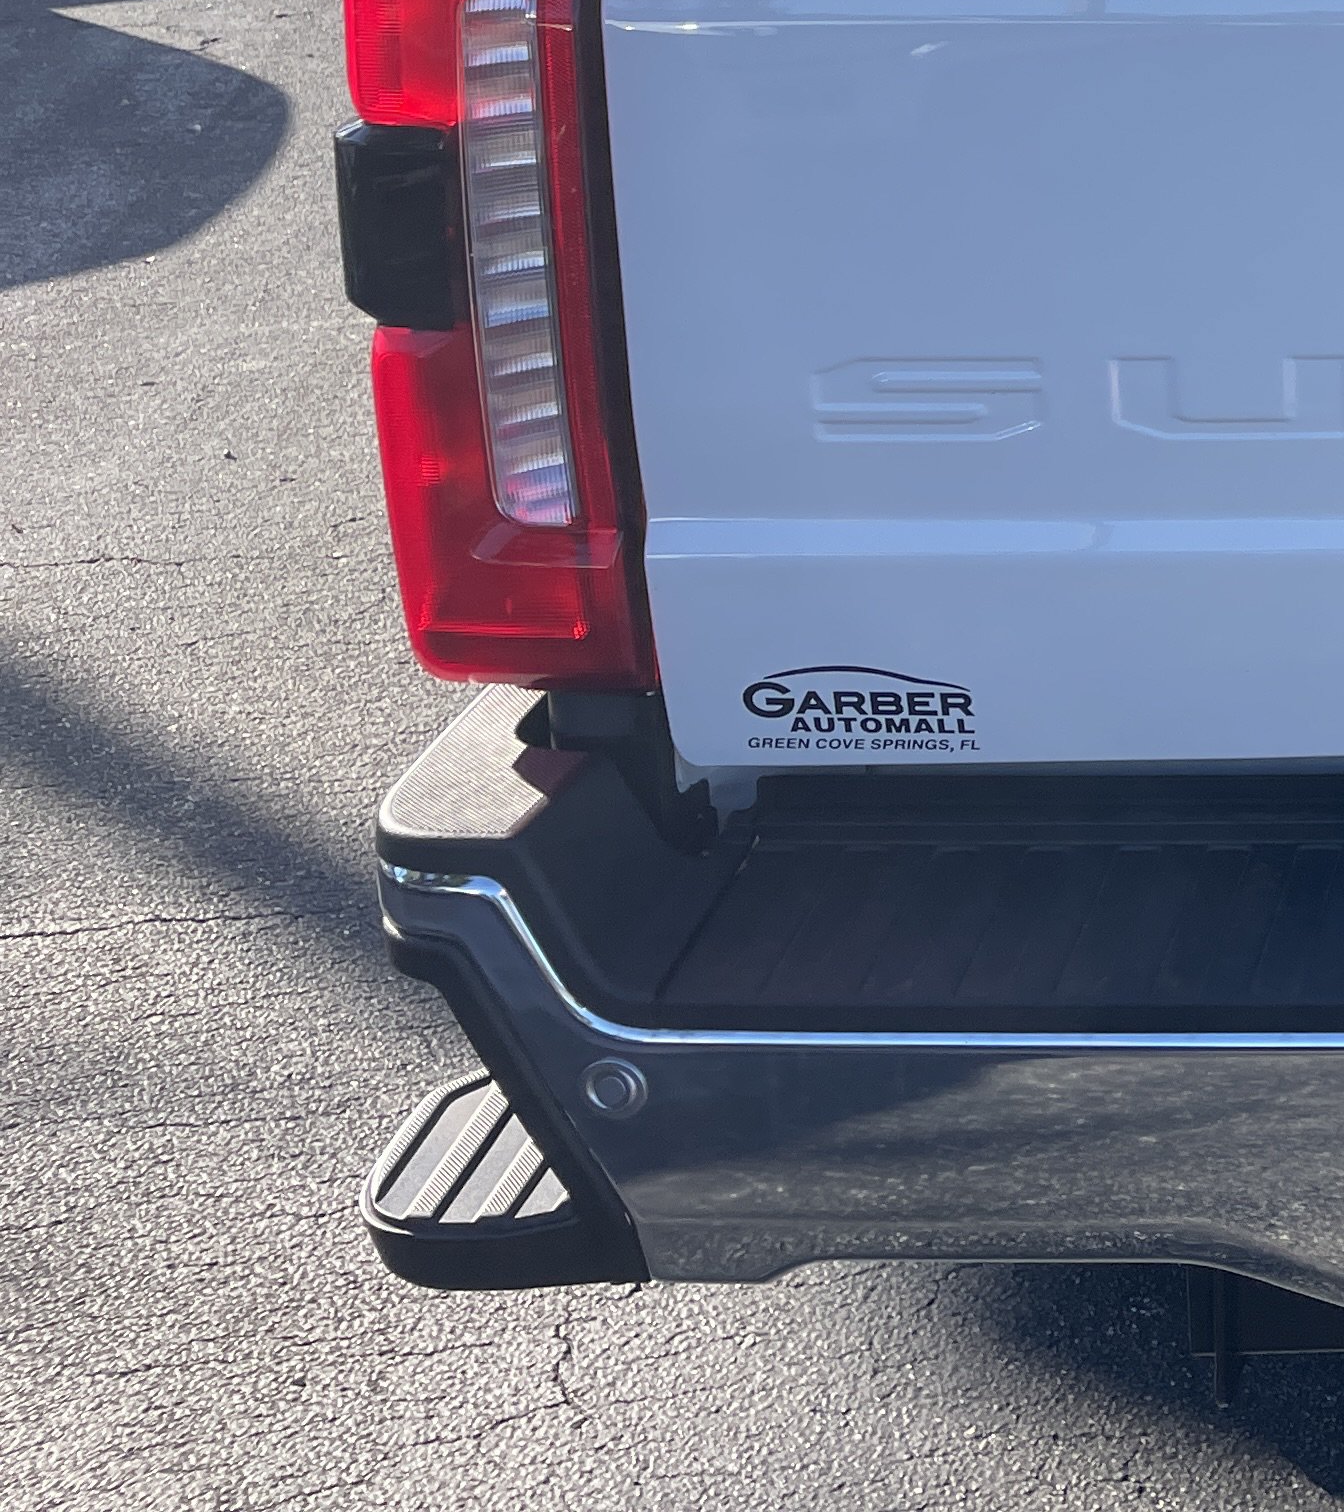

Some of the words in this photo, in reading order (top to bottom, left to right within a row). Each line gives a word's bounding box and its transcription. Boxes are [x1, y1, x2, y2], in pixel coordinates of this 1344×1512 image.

[742, 681, 975, 718] GARBER
[790, 716, 976, 734] AUTOMALL
[748, 737, 810, 750] GREEN
[815, 738, 865, 750] COVE
[870, 739, 955, 753] SPRINGS,
[960, 740, 980, 750] FL
